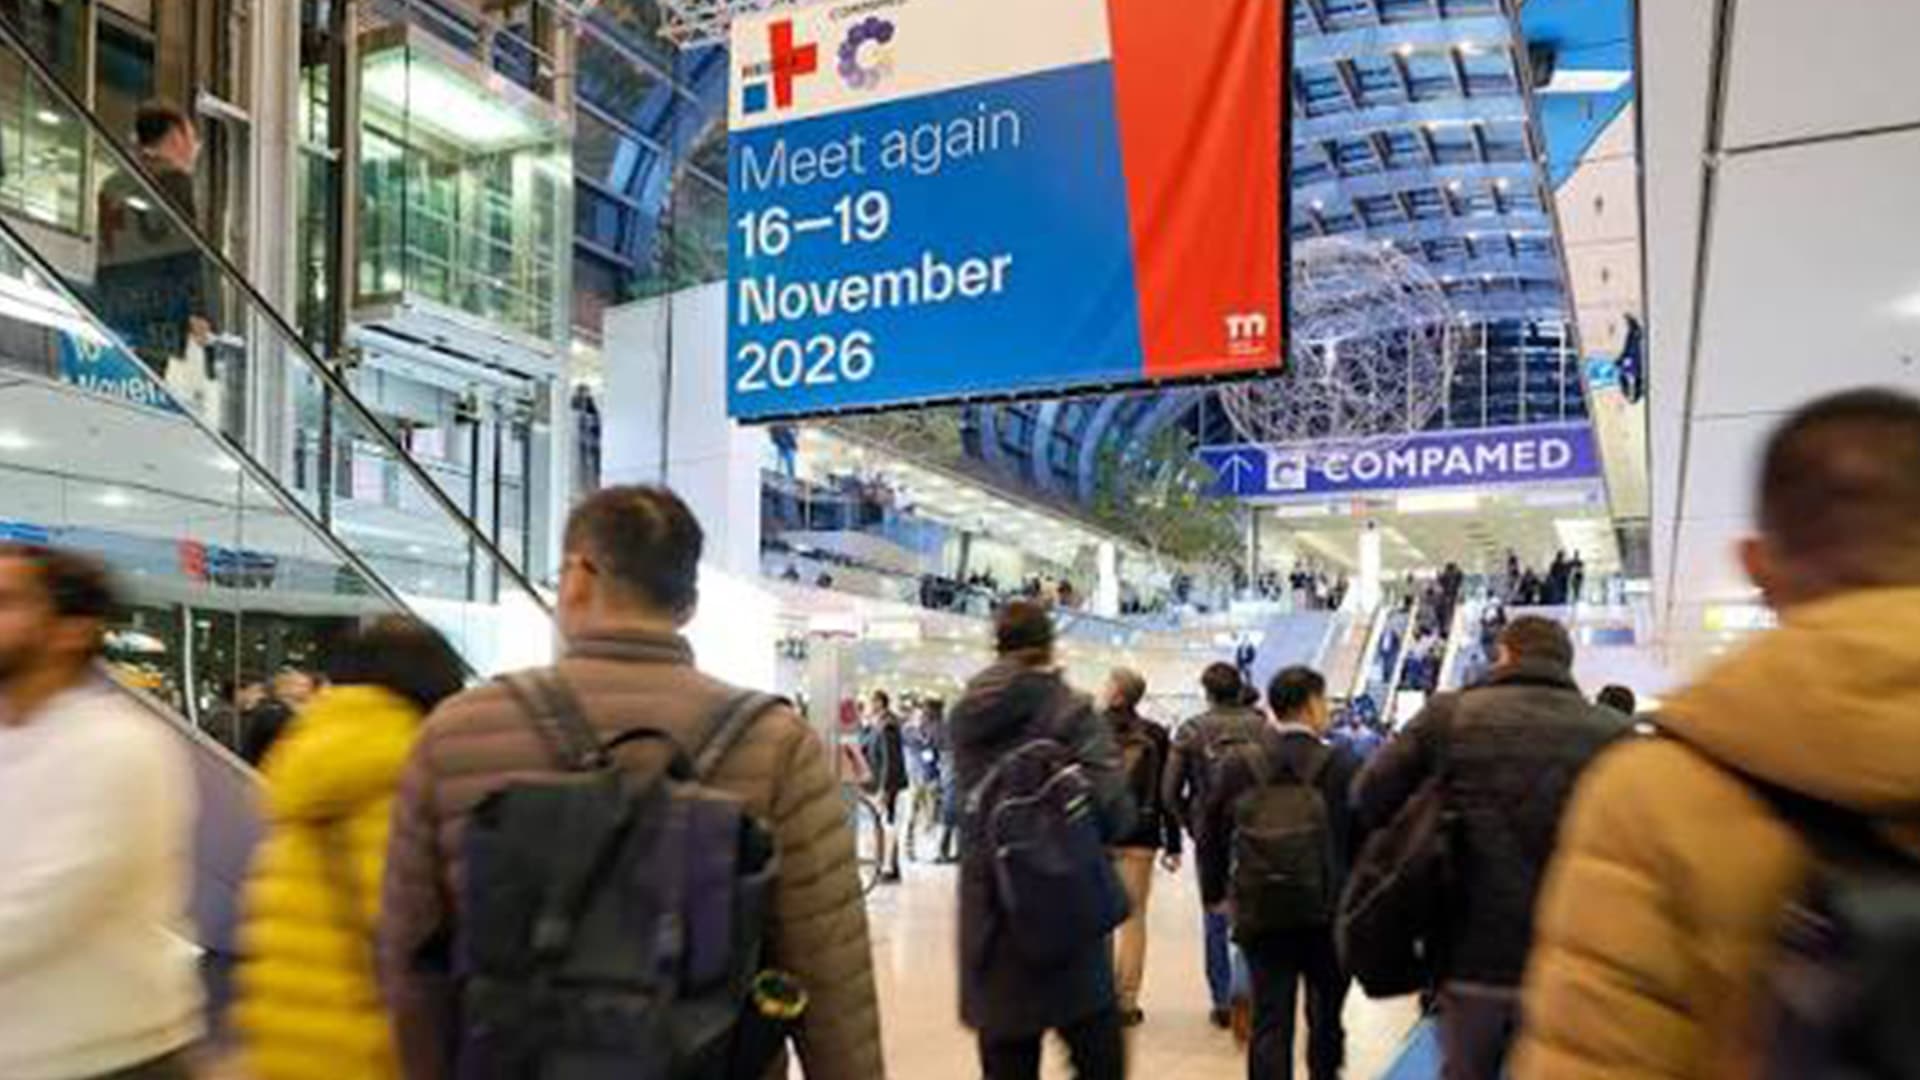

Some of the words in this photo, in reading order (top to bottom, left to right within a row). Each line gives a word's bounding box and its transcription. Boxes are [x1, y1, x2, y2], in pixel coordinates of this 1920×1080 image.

[741, 132, 867, 192] Meet
[880, 101, 1020, 175] again
[738, 250, 1013, 326] November
[735, 330, 875, 393] 2026
[1322, 438, 1572, 483] COMPAMED
